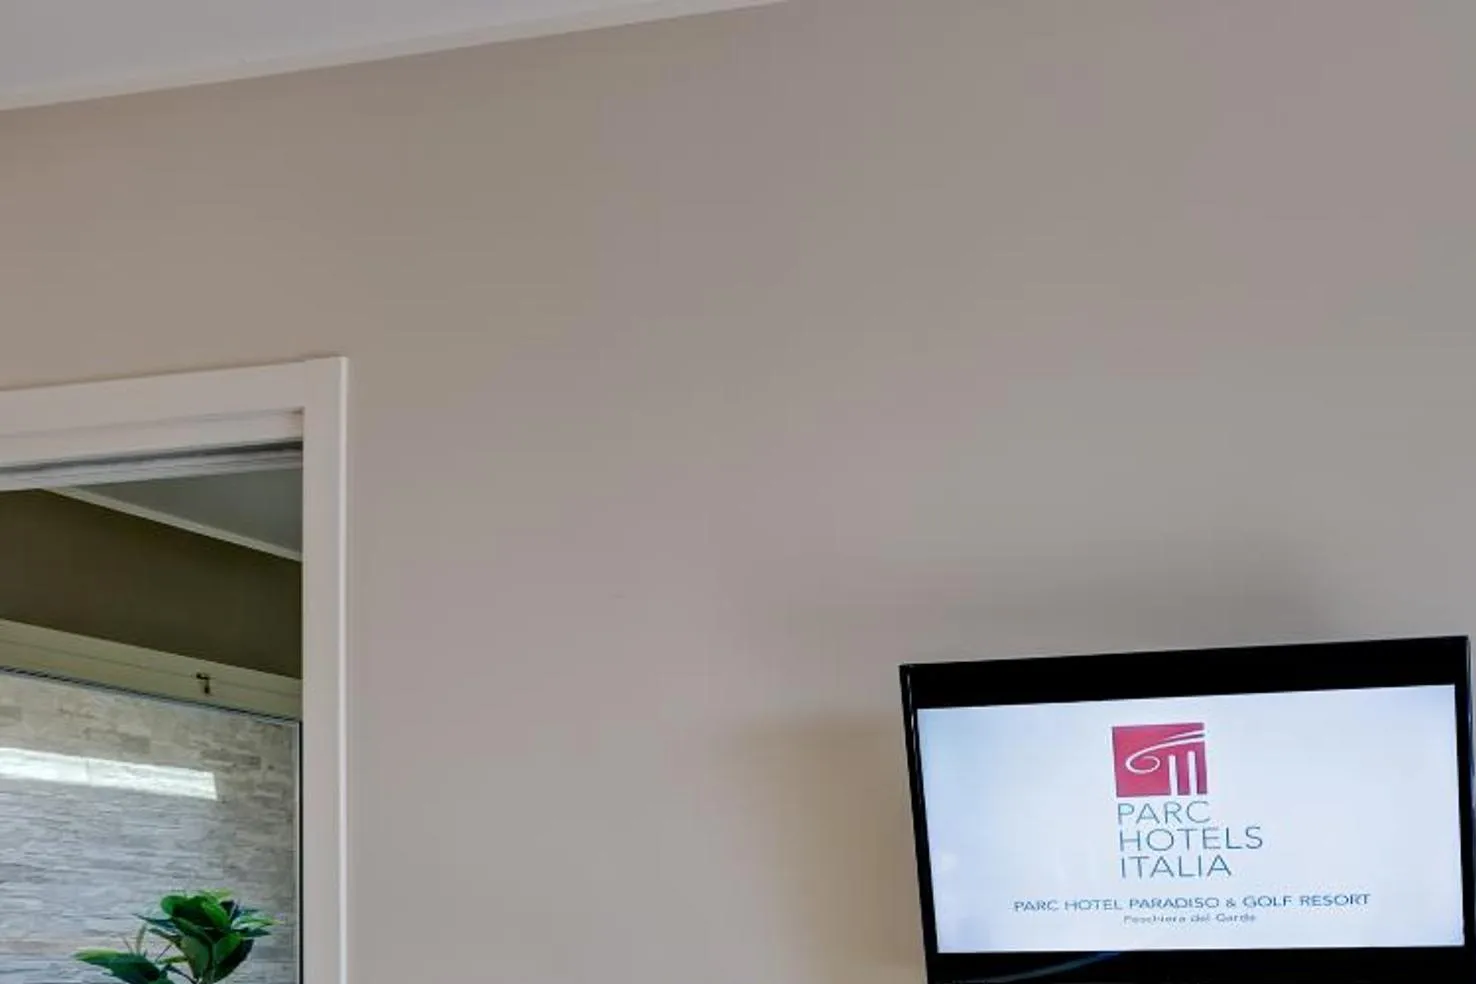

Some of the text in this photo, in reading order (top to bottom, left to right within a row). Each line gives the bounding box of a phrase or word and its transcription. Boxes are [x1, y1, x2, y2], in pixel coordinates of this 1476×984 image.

[1117, 800, 1211, 825] PARC
[1119, 826, 1264, 851] HOTELS
[1121, 854, 1232, 878] ITALIA
[1013, 893, 1371, 912] PARC HOTEL PARADISO & GOLF RESORT
